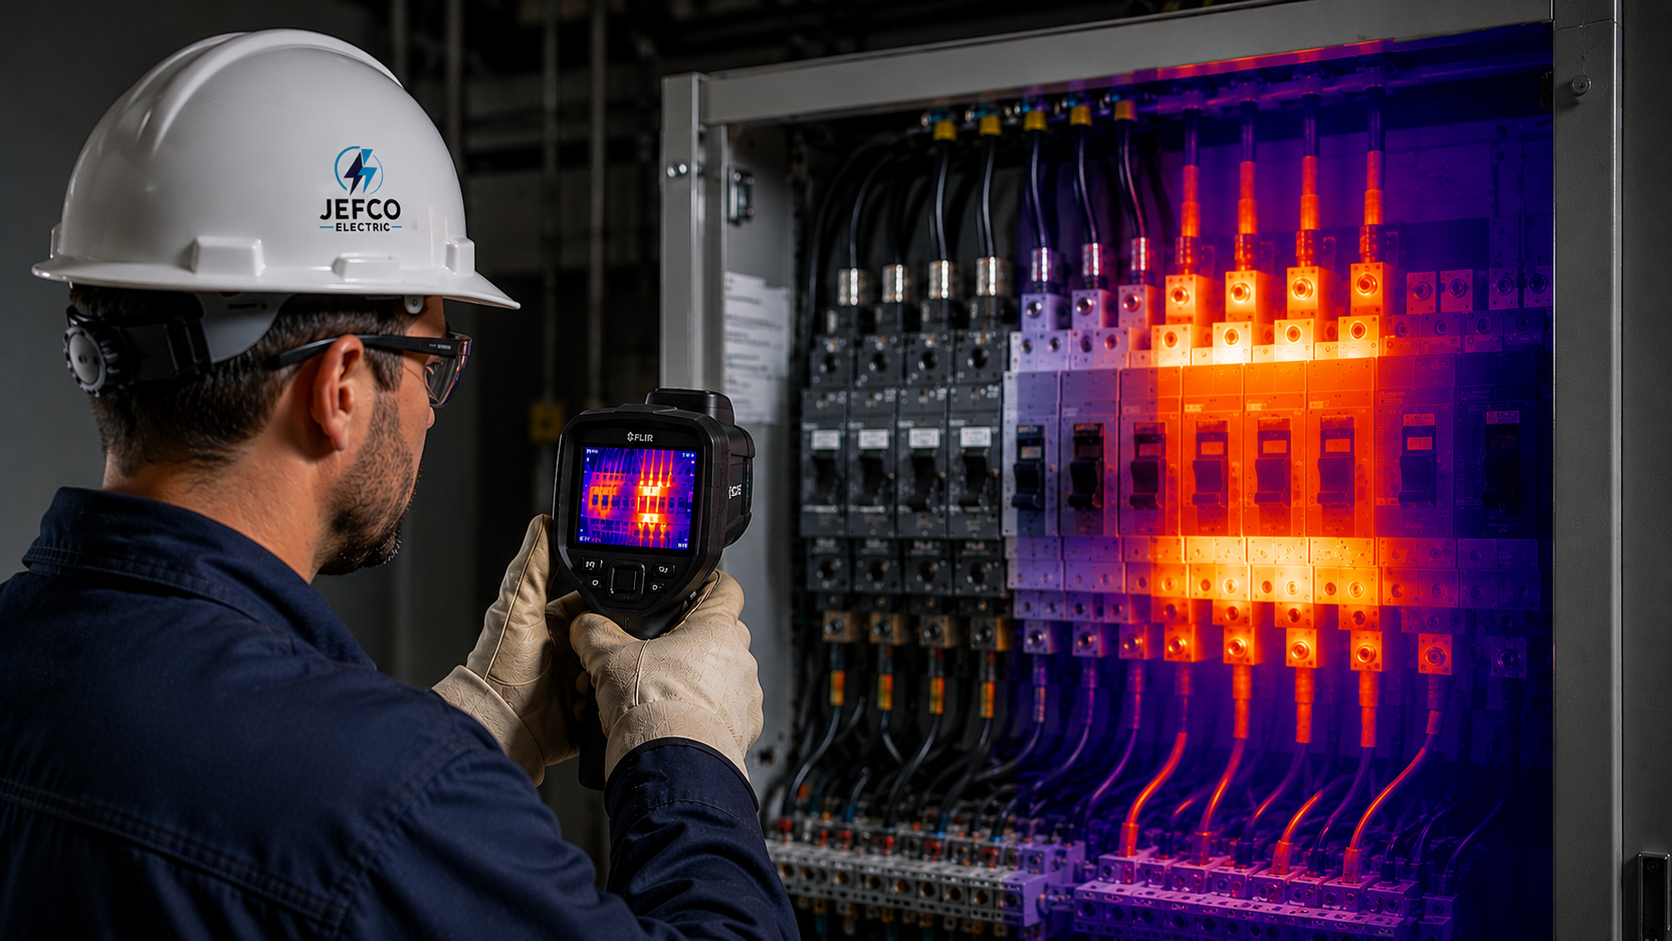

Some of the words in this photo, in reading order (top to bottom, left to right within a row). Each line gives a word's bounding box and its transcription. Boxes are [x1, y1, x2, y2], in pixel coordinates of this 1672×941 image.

[319, 198, 402, 220] JEFCO
[335, 222, 391, 232] ELECTRIC
[634, 434, 654, 442] FLIR
